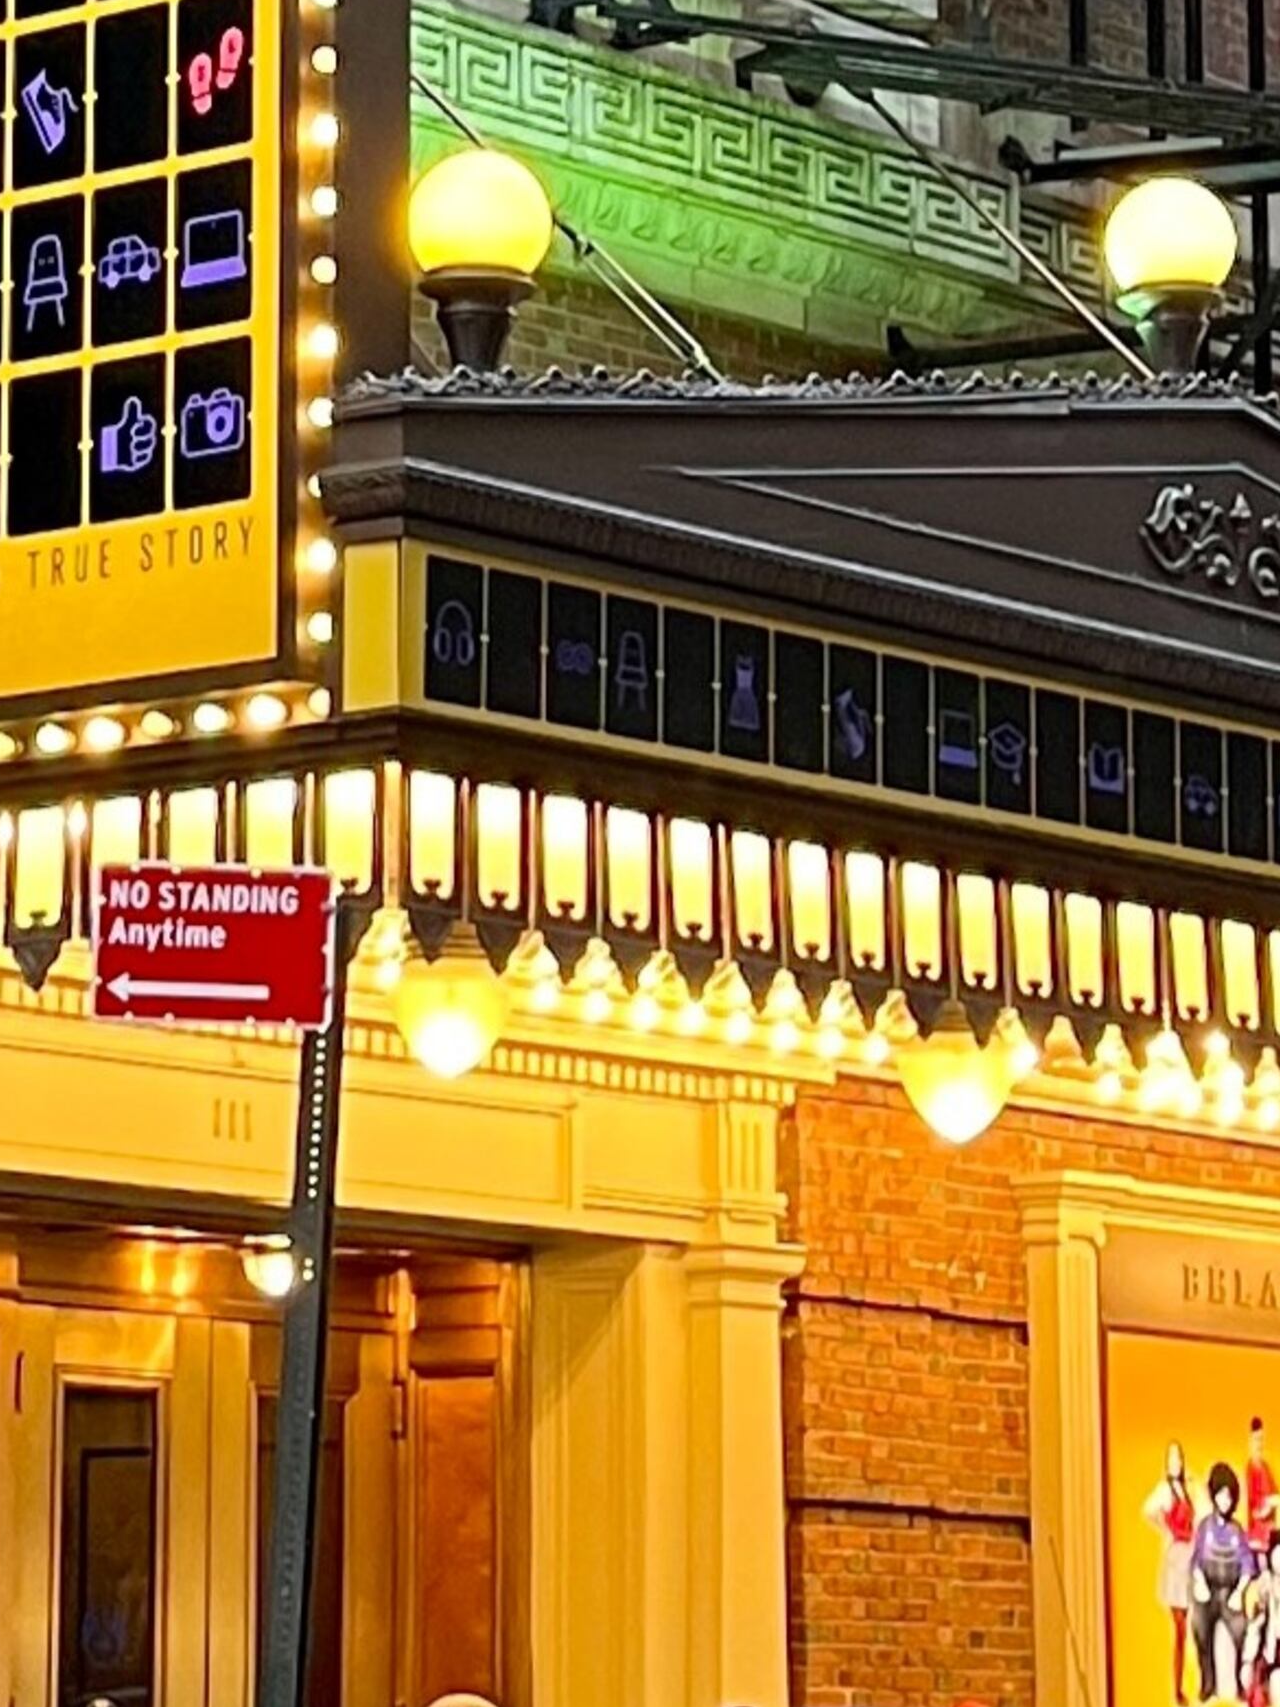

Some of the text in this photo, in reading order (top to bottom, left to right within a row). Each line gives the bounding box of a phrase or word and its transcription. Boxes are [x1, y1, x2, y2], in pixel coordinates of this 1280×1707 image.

[26, 538, 113, 590] TRUE
[139, 516, 257, 573] STORY
[109, 879, 299, 915] NO STANDING
[108, 916, 227, 953] Anytime
[213, 1098, 251, 1142] 111
